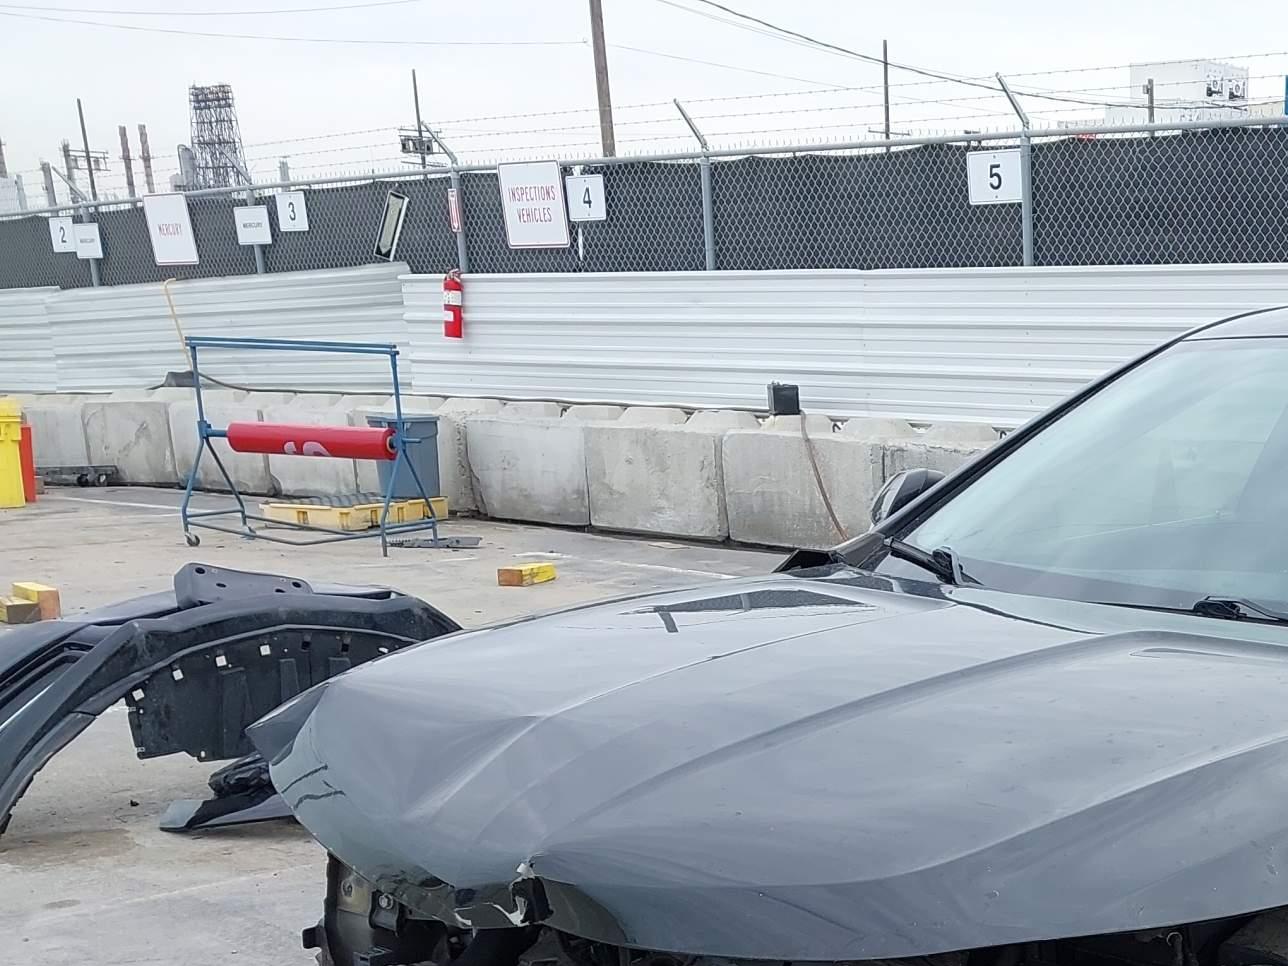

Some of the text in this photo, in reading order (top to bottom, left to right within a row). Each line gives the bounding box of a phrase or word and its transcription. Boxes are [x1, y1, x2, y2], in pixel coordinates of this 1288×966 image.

[990, 164, 1002, 190] 5
[508, 186, 555, 201] INSPECTIONS
[583, 188, 592, 208] 4
[288, 202, 296, 221] 3
[517, 207, 553, 224] VEHICLES
[60, 226, 67, 243] 2
